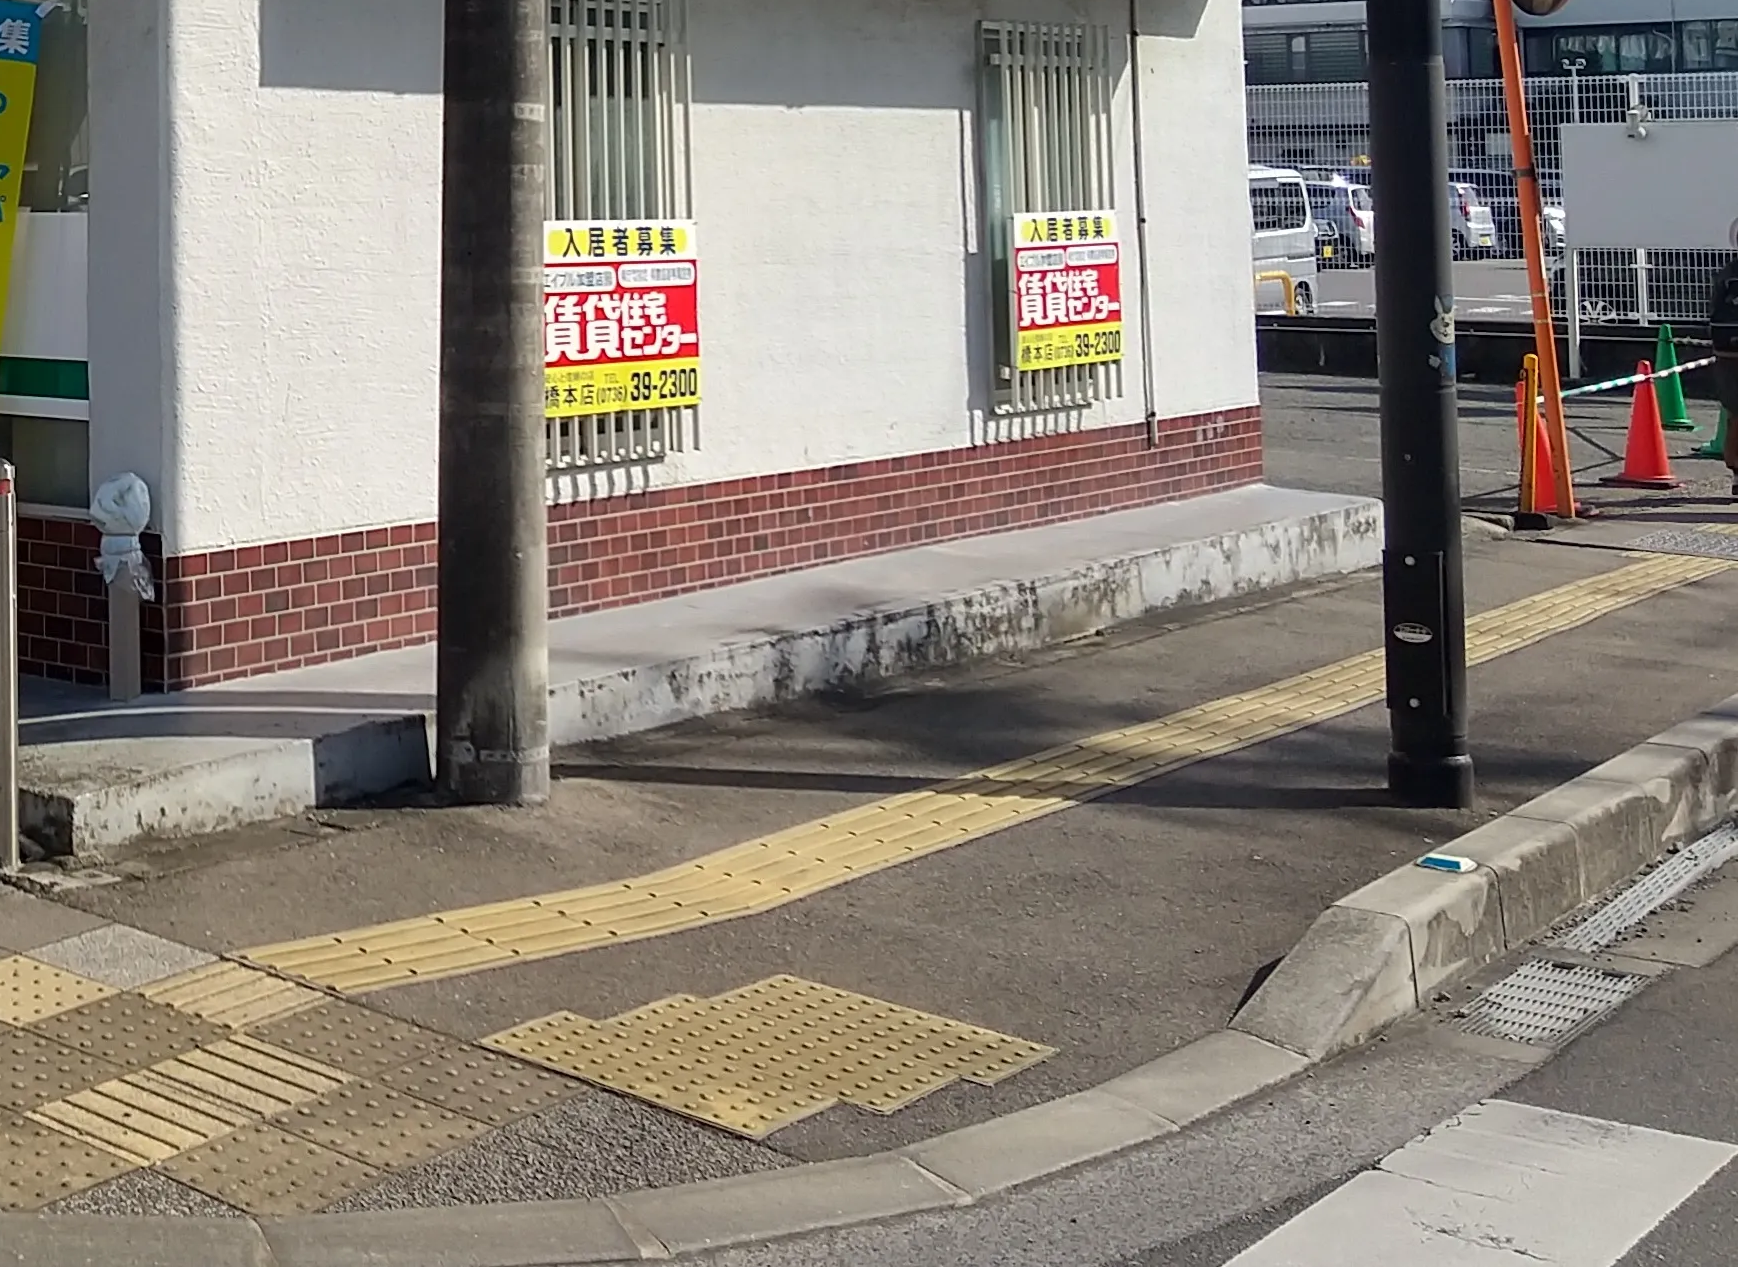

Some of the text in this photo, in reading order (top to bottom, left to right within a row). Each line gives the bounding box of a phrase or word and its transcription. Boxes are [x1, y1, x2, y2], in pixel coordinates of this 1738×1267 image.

[563, 226, 677, 258] 入居者募集
[1029, 216, 1105, 243] 入居者募集
[1022, 343, 1053, 364] 橋本店
[1075, 330, 1121, 358] 39-2300
[545, 383, 595, 410] 橋本店
[629, 367, 698, 402] 39-2300
